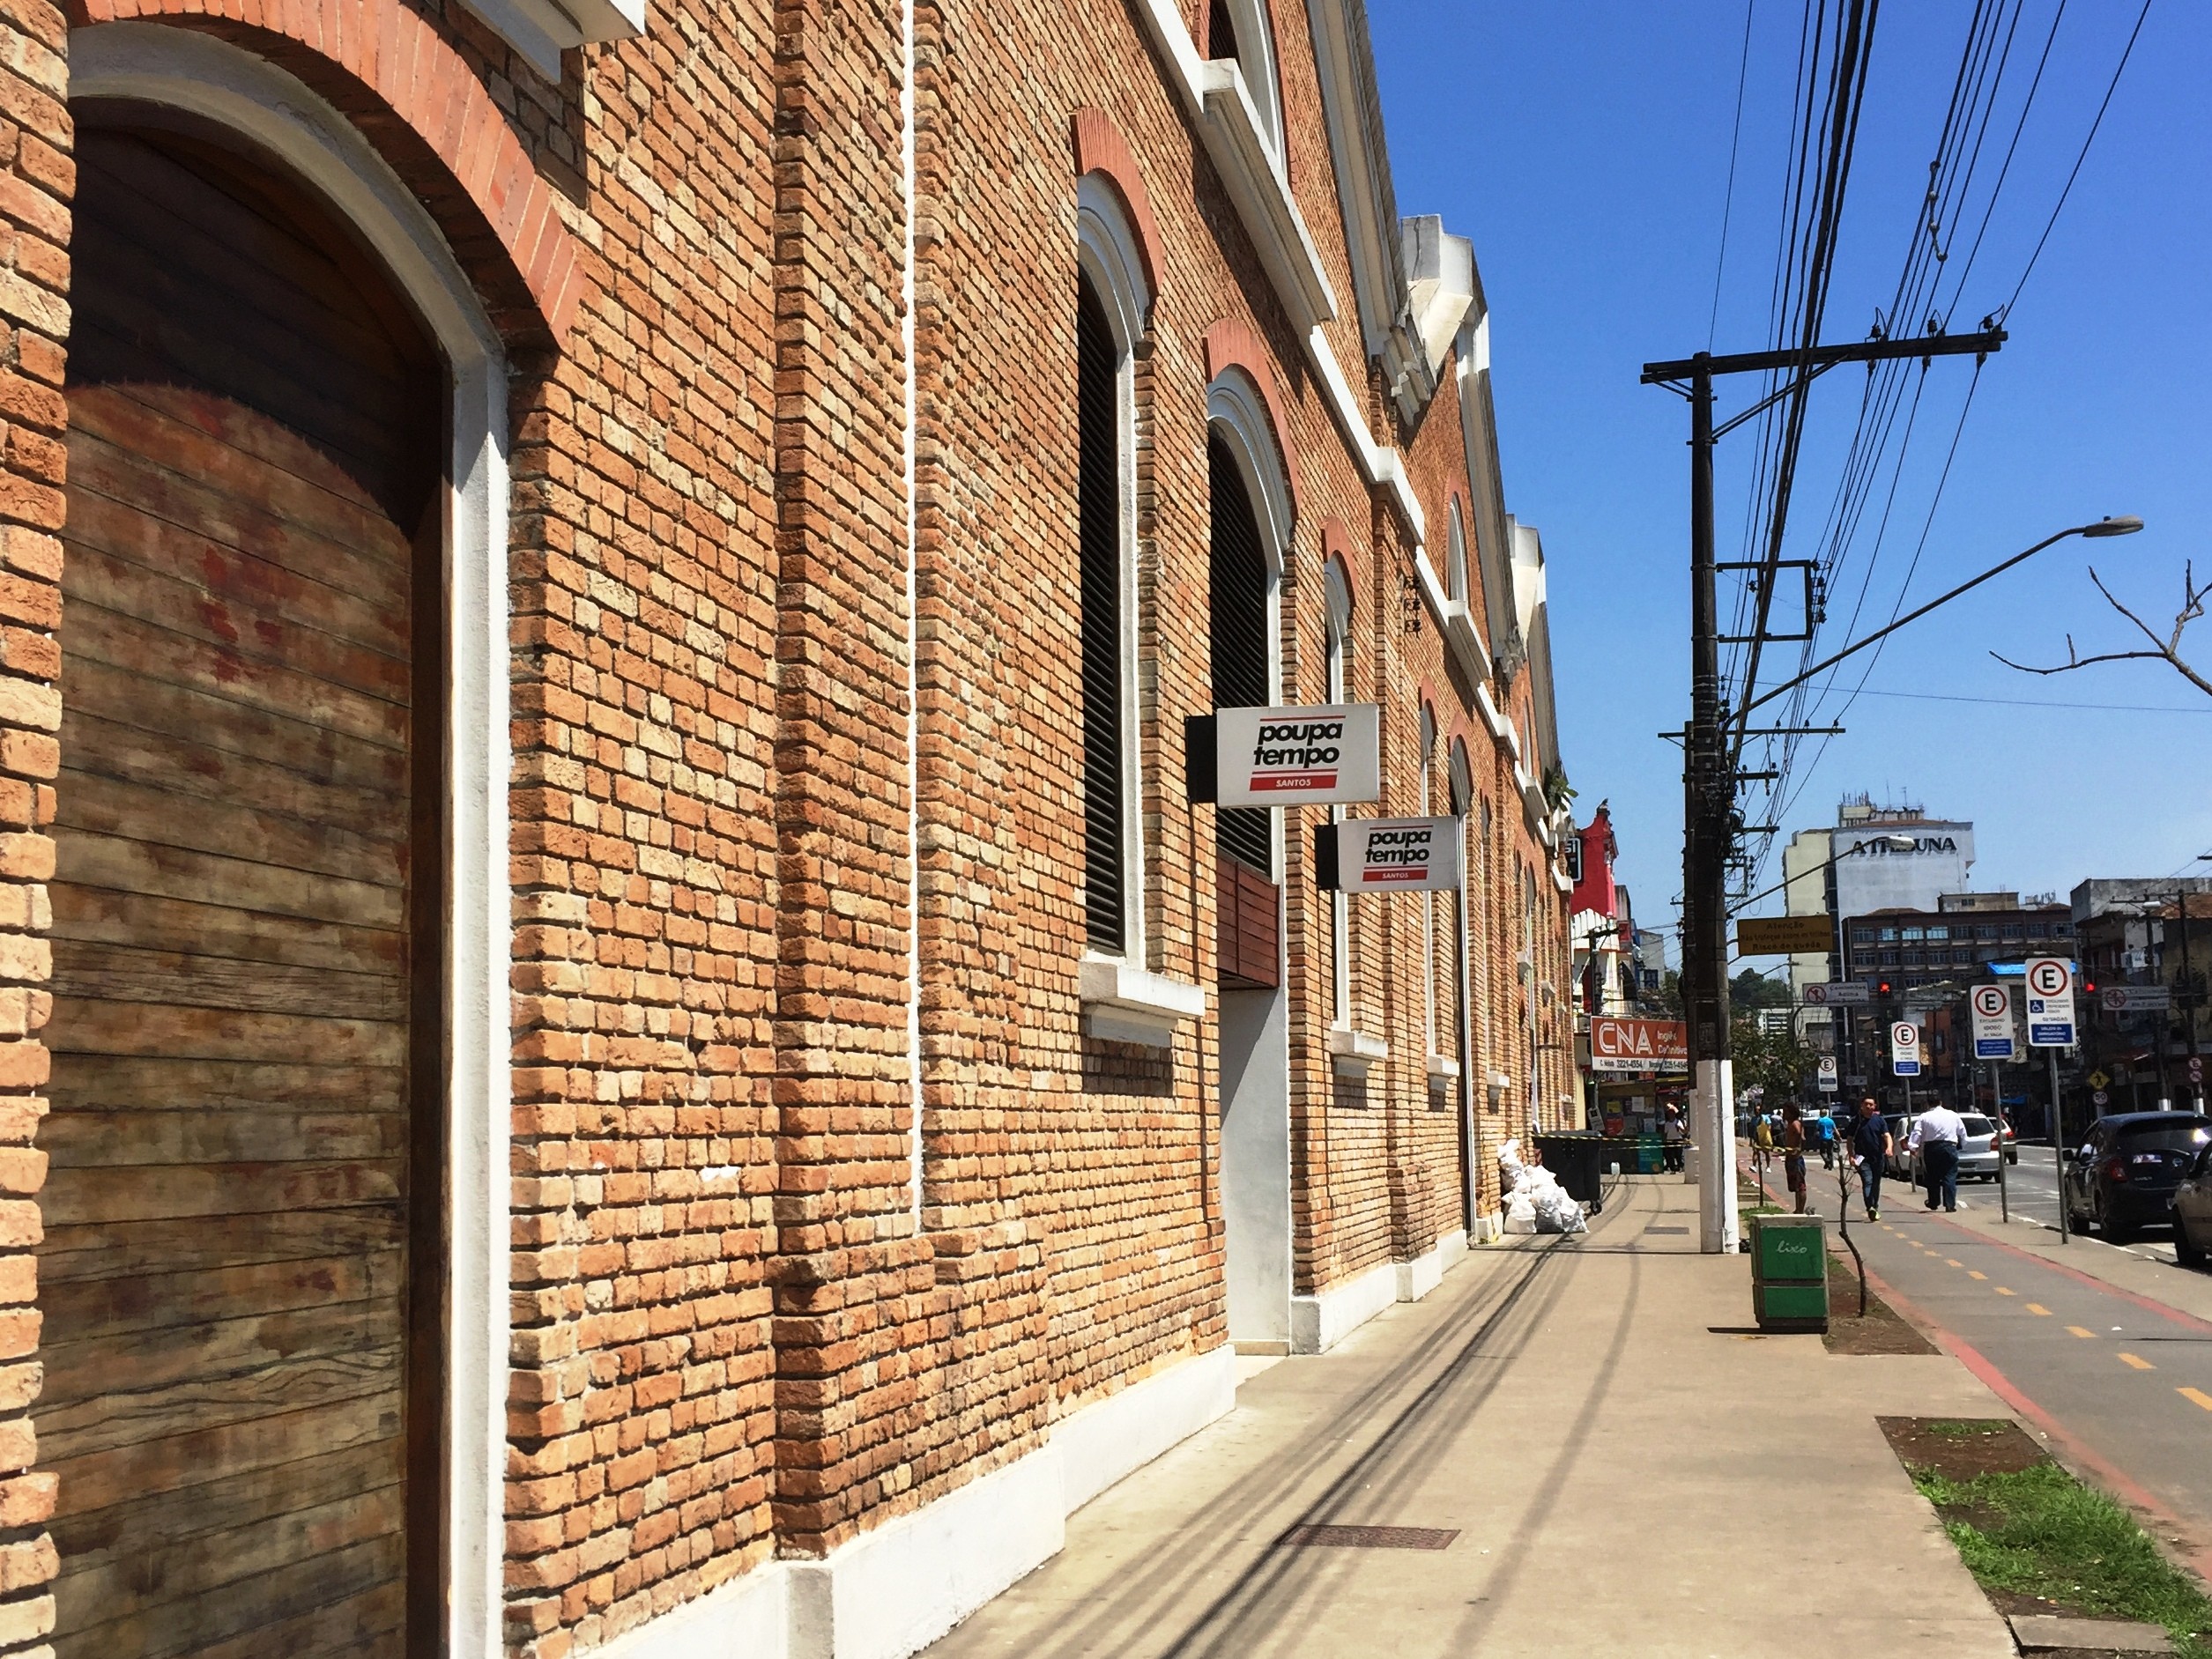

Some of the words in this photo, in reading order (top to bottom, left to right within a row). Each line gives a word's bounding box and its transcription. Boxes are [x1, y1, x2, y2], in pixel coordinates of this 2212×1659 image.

[1258, 723, 1343, 746] poupa
[1253, 746, 1340, 769] tempo
[1275, 779, 1311, 788] SANTOS
[1368, 831, 1432, 848] poupa
[1869, 837, 1957, 855] TUNA
[1365, 848, 1429, 865] tempo
[2042, 969, 2057, 989] E
[1985, 994, 1997, 1010] E
[1599, 1022, 1653, 1055] CNA
[1901, 1029, 1909, 1041] E
